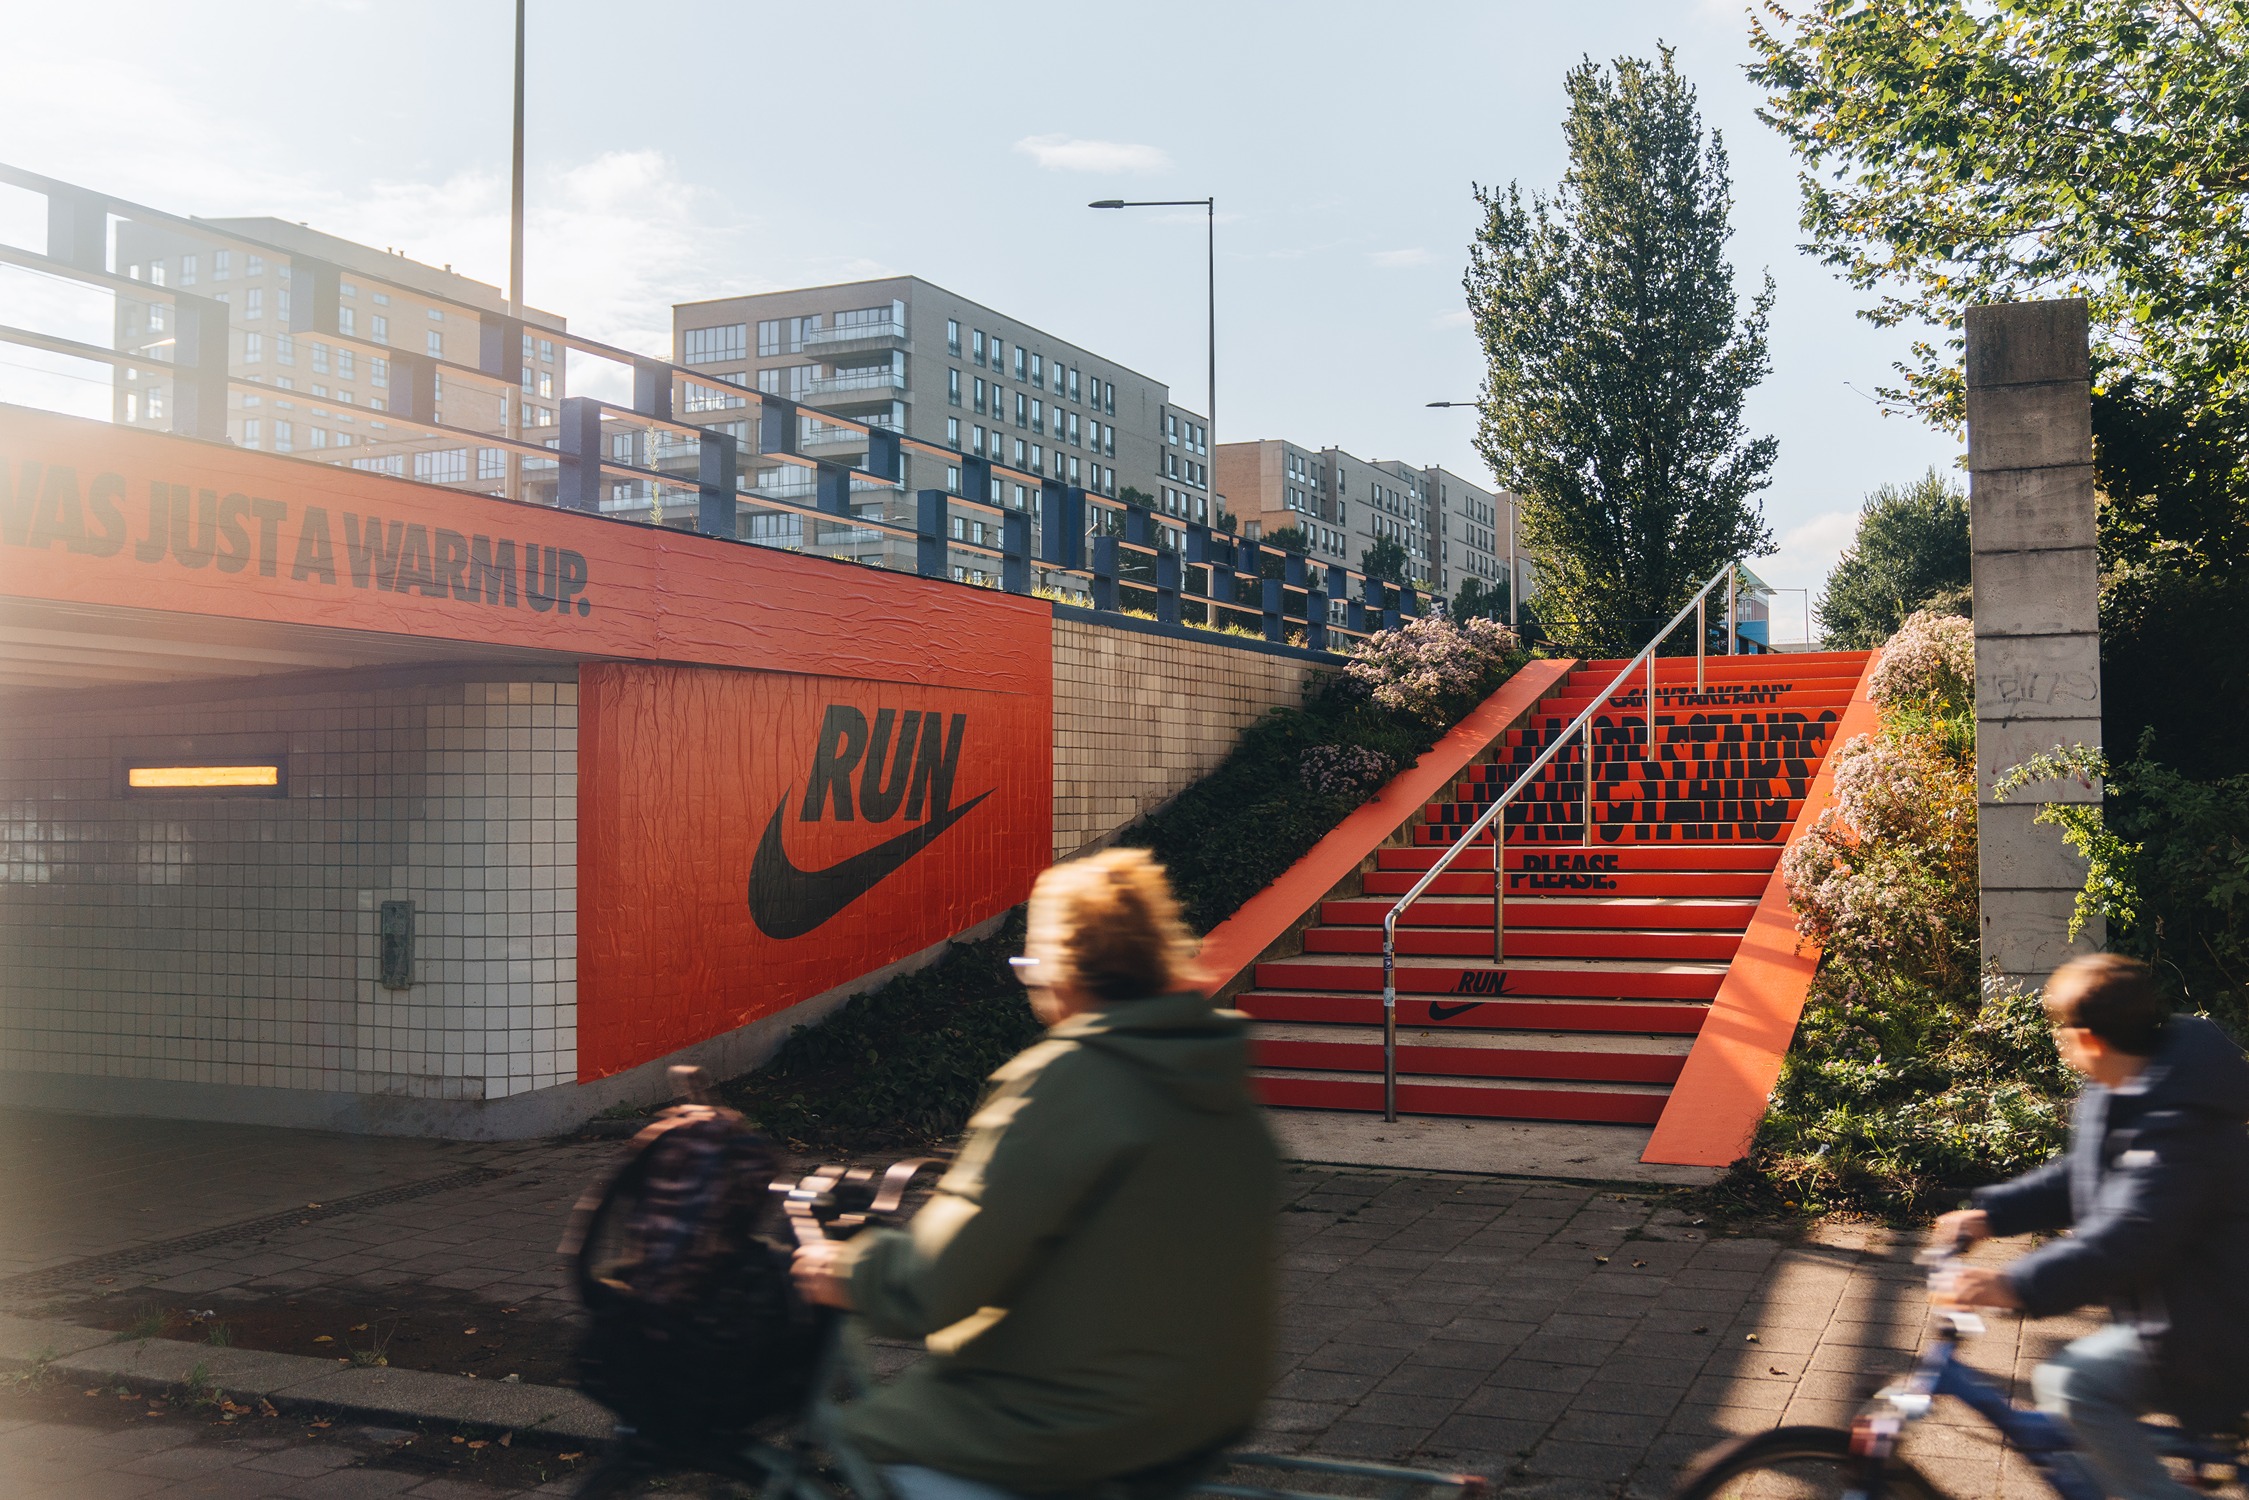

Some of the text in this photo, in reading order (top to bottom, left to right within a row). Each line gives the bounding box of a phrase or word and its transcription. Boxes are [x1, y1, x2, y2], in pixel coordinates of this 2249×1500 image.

[135, 480, 287, 577] JUST
[291, 505, 336, 585] A
[343, 511, 517, 608] WARM
[525, 542, 591, 617] UP.
[1677, 684, 1745, 706] TAKE
[1731, 683, 1792, 704] ANY
[800, 704, 967, 823] RUN
[1429, 710, 1837, 842] MORE STAIRS
[1510, 854, 1618, 890] PLEASE.
[1457, 971, 1508, 993] RUN
